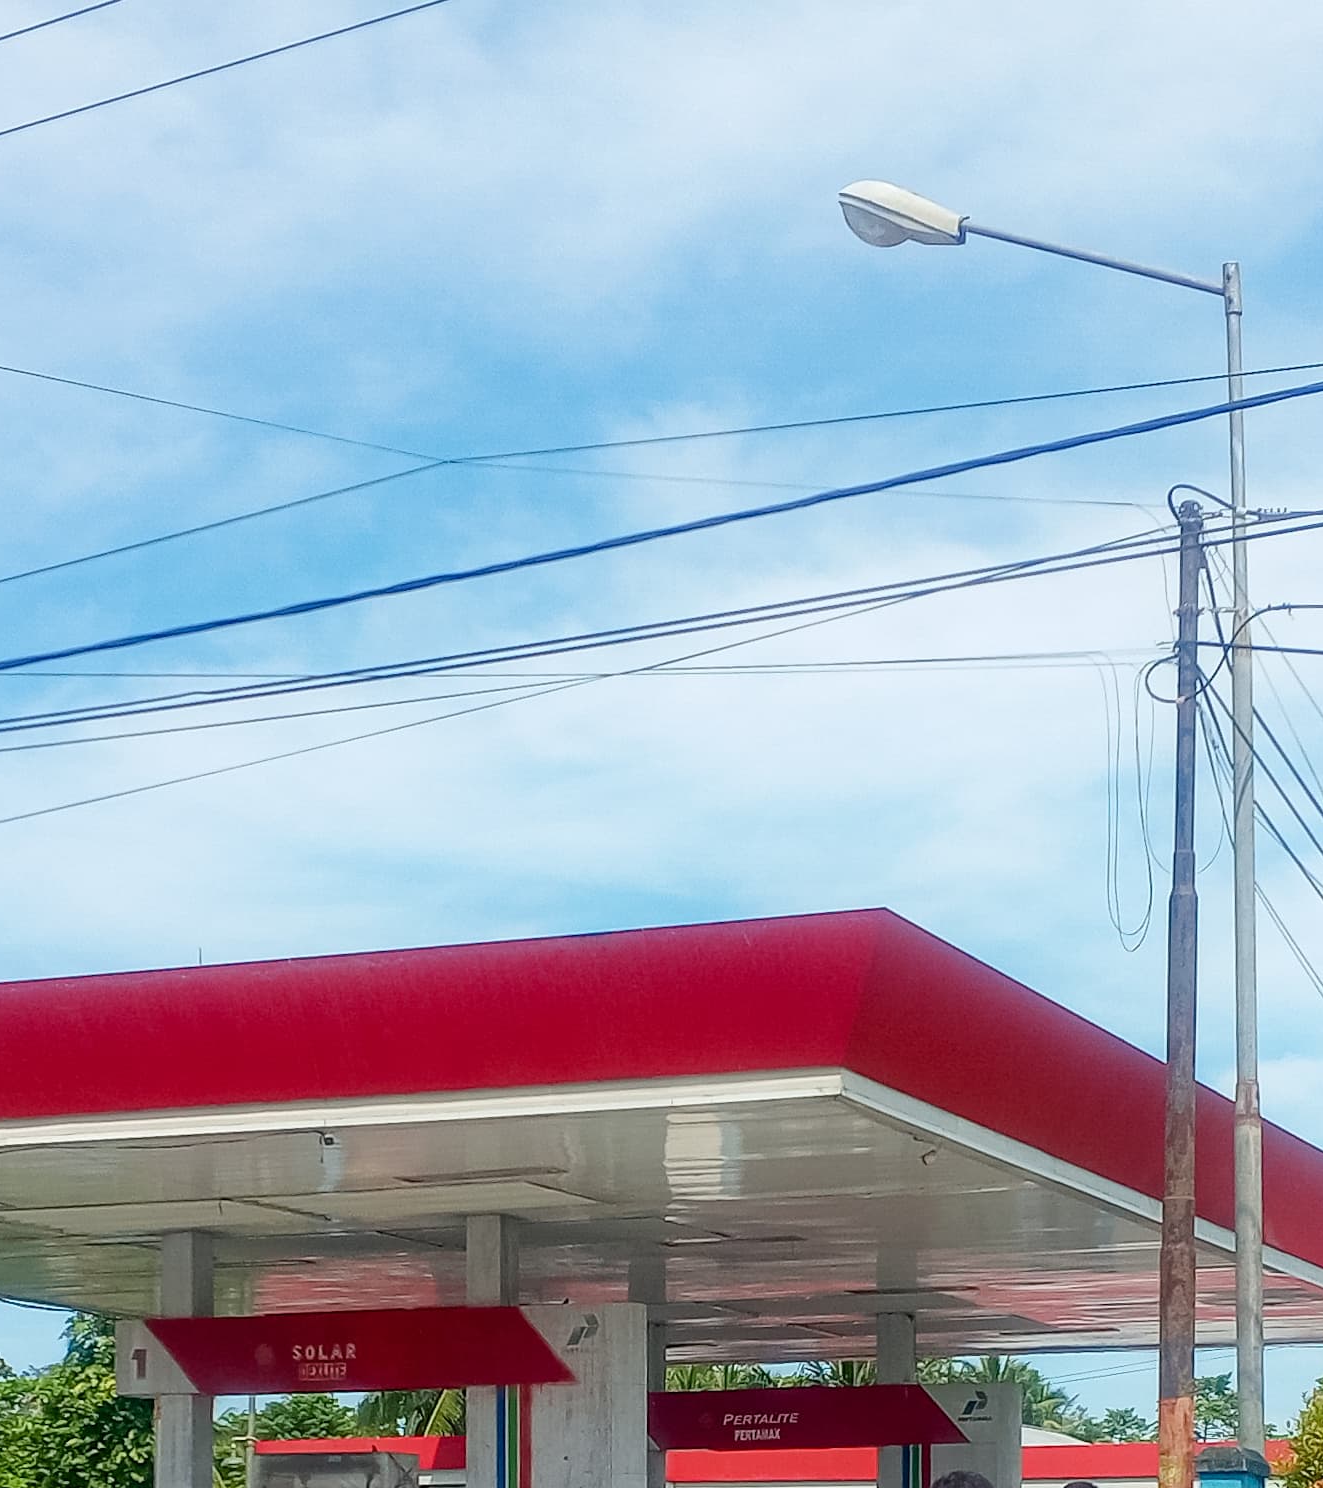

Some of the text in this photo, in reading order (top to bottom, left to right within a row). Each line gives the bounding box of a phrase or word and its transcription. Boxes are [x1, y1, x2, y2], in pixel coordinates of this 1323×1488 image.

[292, 1342, 357, 1361] SOLAR
[131, 1348, 147, 1379] 1
[722, 1412, 800, 1427] PERTALITE
